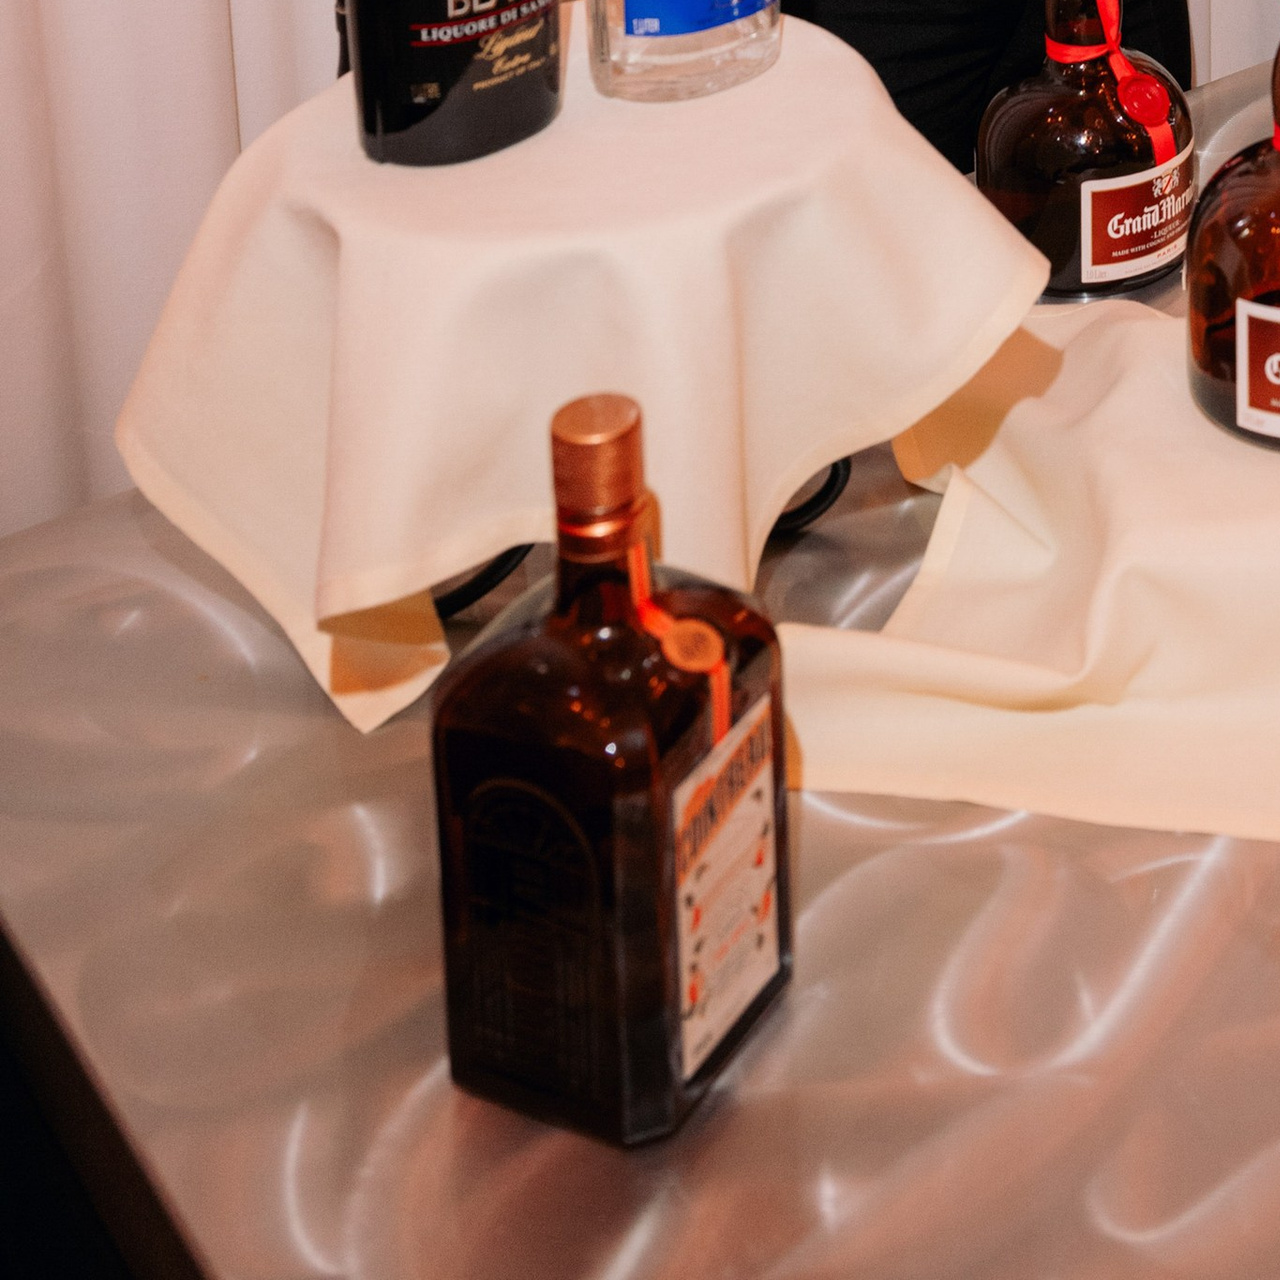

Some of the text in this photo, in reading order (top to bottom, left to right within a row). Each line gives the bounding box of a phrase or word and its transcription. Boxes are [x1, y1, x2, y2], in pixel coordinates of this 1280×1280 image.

[421, 15, 498, 42] LIQUORE
[500, 8, 518, 26] DI
[1107, 204, 1159, 239] Grand
[1111, 248, 1130, 257] MADE
[1130, 244, 1146, 253] WITH
